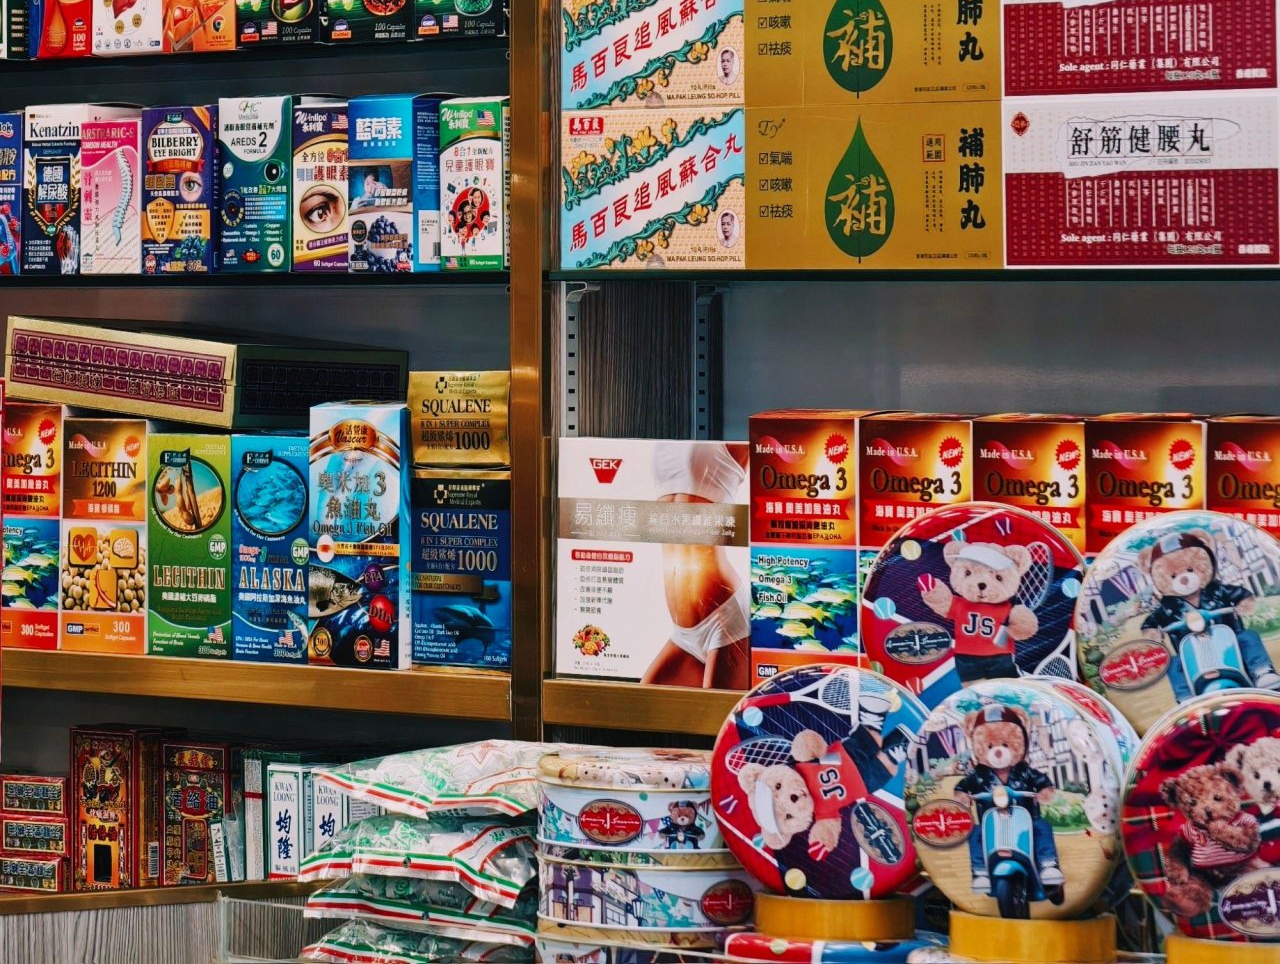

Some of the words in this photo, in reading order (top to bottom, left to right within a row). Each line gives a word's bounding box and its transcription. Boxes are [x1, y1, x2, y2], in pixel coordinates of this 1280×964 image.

[1059, 63, 1077, 72] Sole
[29, 122, 79, 139] Kenatzin
[151, 136, 200, 149] BILBERRY
[231, 137, 256, 147] AREDS
[258, 132, 267, 148] 2
[1072, 123, 1210, 156] 舒筋健腰丸
[153, 148, 168, 157] EYE
[170, 146, 198, 157] BRIGHT
[243, 147, 267, 155] FORMULA
[958, 128, 986, 231] 補肺丸
[421, 399, 491, 416] SQUALENE
[455, 432, 490, 450] 1000
[755, 443, 774, 455] Made
[784, 444, 805, 455] U.S.A.
[866, 447, 884, 457] Made
[71, 461, 137, 479] LECITHIN
[593, 459, 617, 470] GEK
[92, 480, 116, 497] 1200
[761, 465, 830, 498] Omega
[836, 467, 847, 491] 3
[872, 468, 945, 502] Omega
[986, 471, 1061, 505] Omega
[1099, 471, 1174, 504] Omega
[421, 512, 499, 532] SQUALENE
[440, 536, 462, 545] SUPER
[464, 537, 498, 546] COMPLEX
[457, 550, 497, 571] 1000
[758, 556, 775, 567] High
[777, 557, 809, 568] Potency
[153, 566, 226, 590] LECITHIN
[239, 567, 305, 590] ALASKA
[758, 574, 785, 586] Omega
[113, 621, 130, 633] 300
[963, 612, 993, 637] JS
[758, 666, 778, 677] GMP
[273, 792, 295, 803] LOONG
[316, 794, 339, 806] LOONG
[276, 809, 293, 860] 均隆
